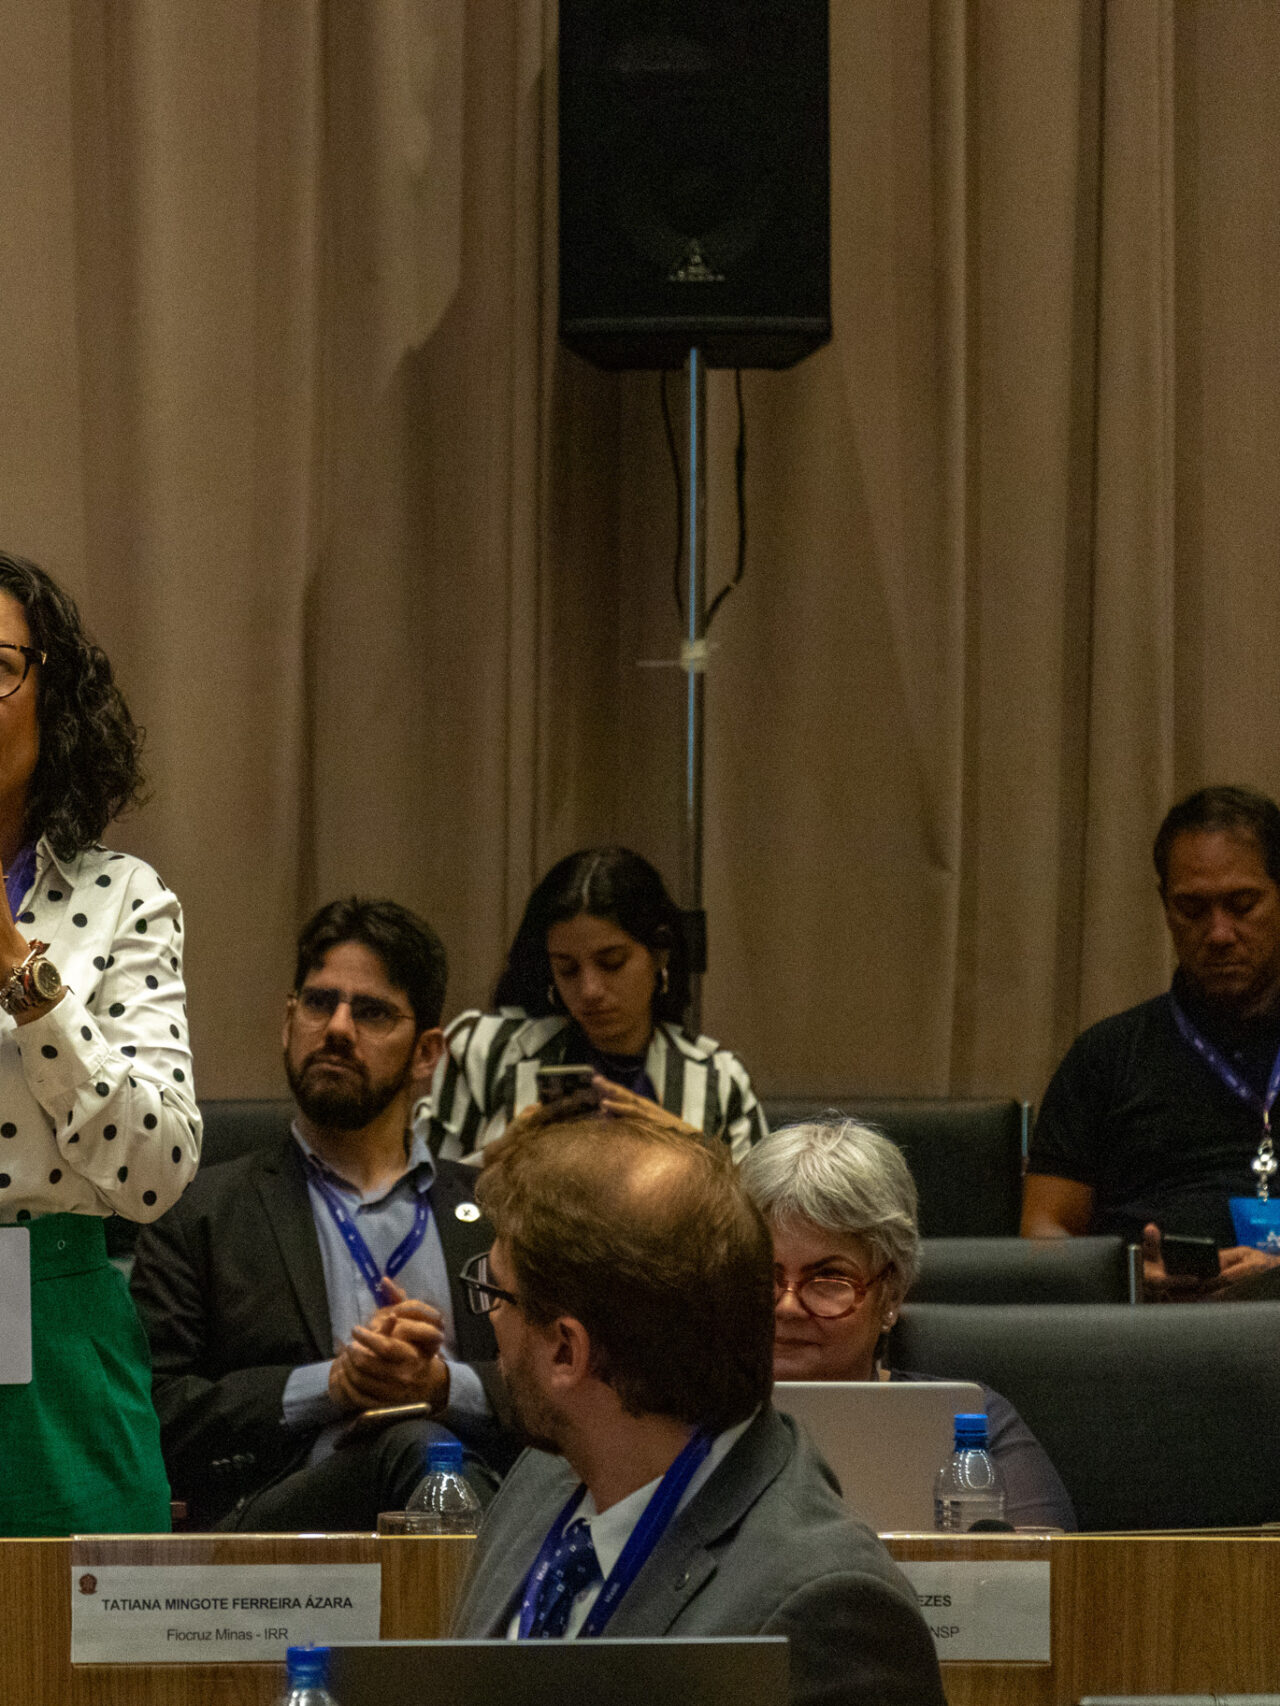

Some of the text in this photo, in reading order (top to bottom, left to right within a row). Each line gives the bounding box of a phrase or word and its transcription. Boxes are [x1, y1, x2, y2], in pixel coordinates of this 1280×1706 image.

[101, 1594, 353, 1611] TATIANA MINGOTE FERREIRA ÁZARA
[166, 1628, 212, 1641] Fiocruz
[215, 1628, 253, 1641] Minas
[264, 1627, 289, 1640] IRR
